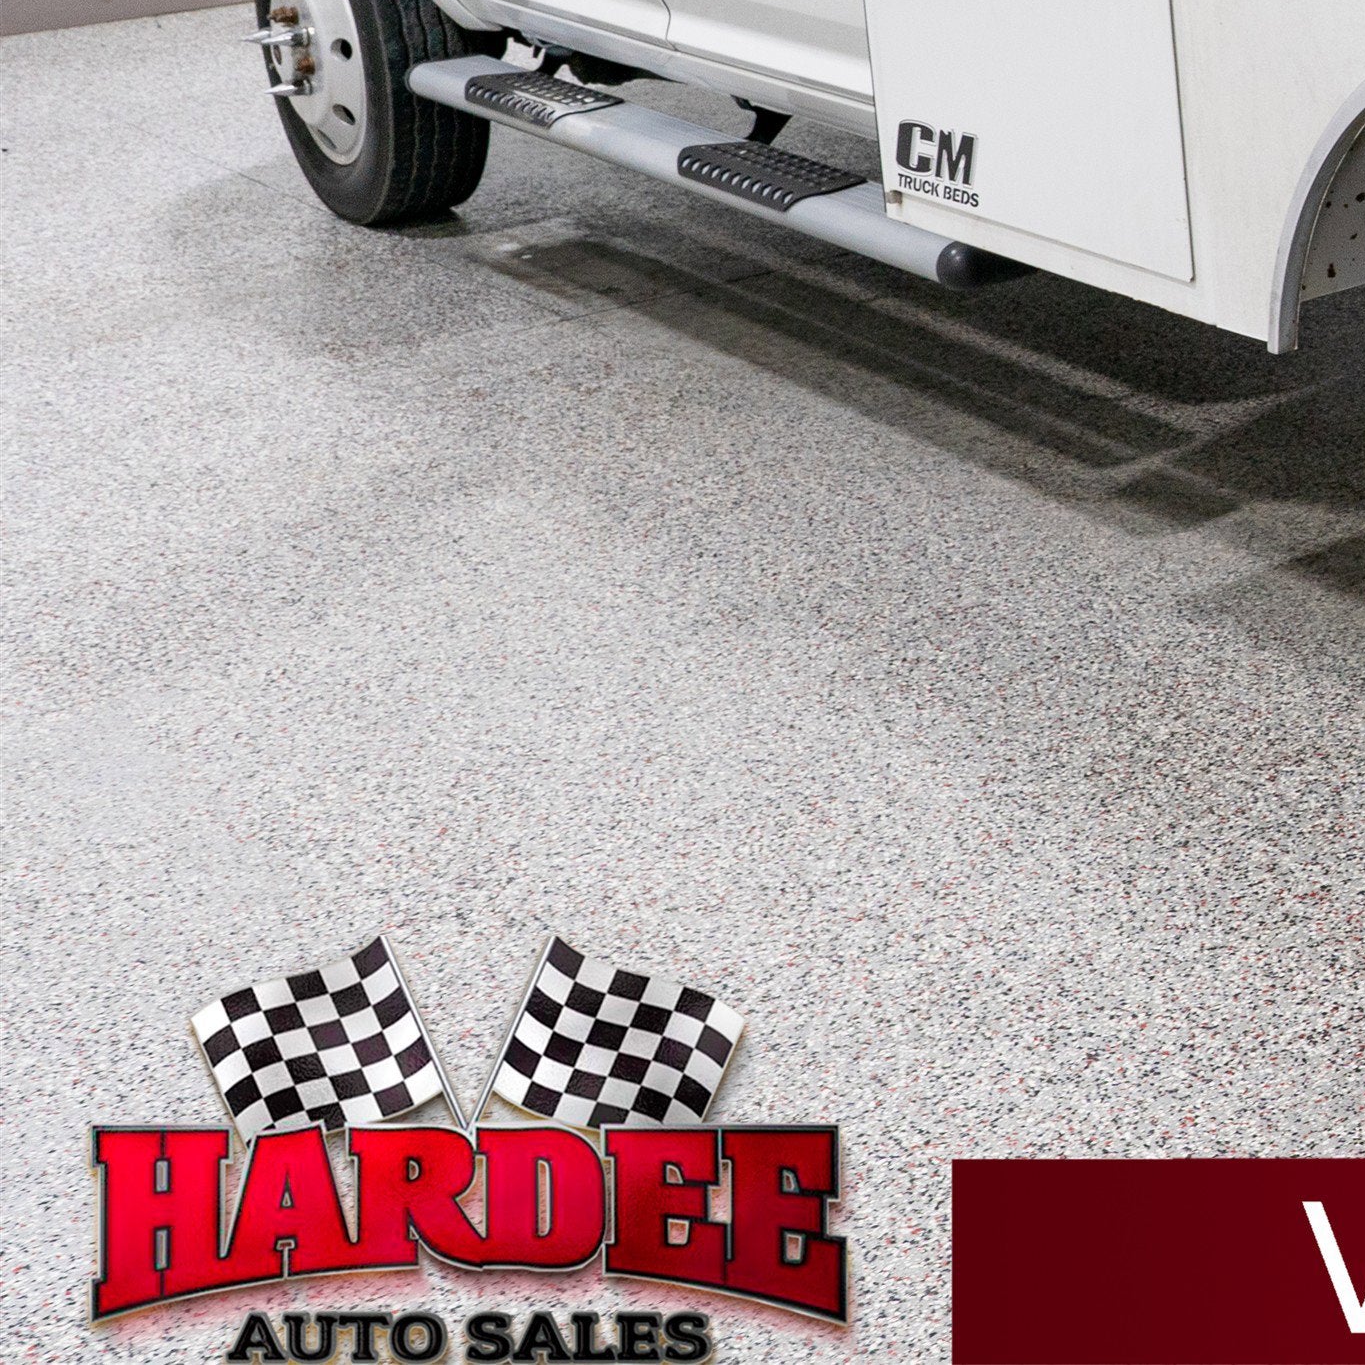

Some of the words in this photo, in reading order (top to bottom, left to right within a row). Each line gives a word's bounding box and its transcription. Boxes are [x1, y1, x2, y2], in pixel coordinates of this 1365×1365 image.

[896, 119, 978, 189] CM
[897, 173, 940, 197] TRUCK
[943, 186, 980, 208] BEDS
